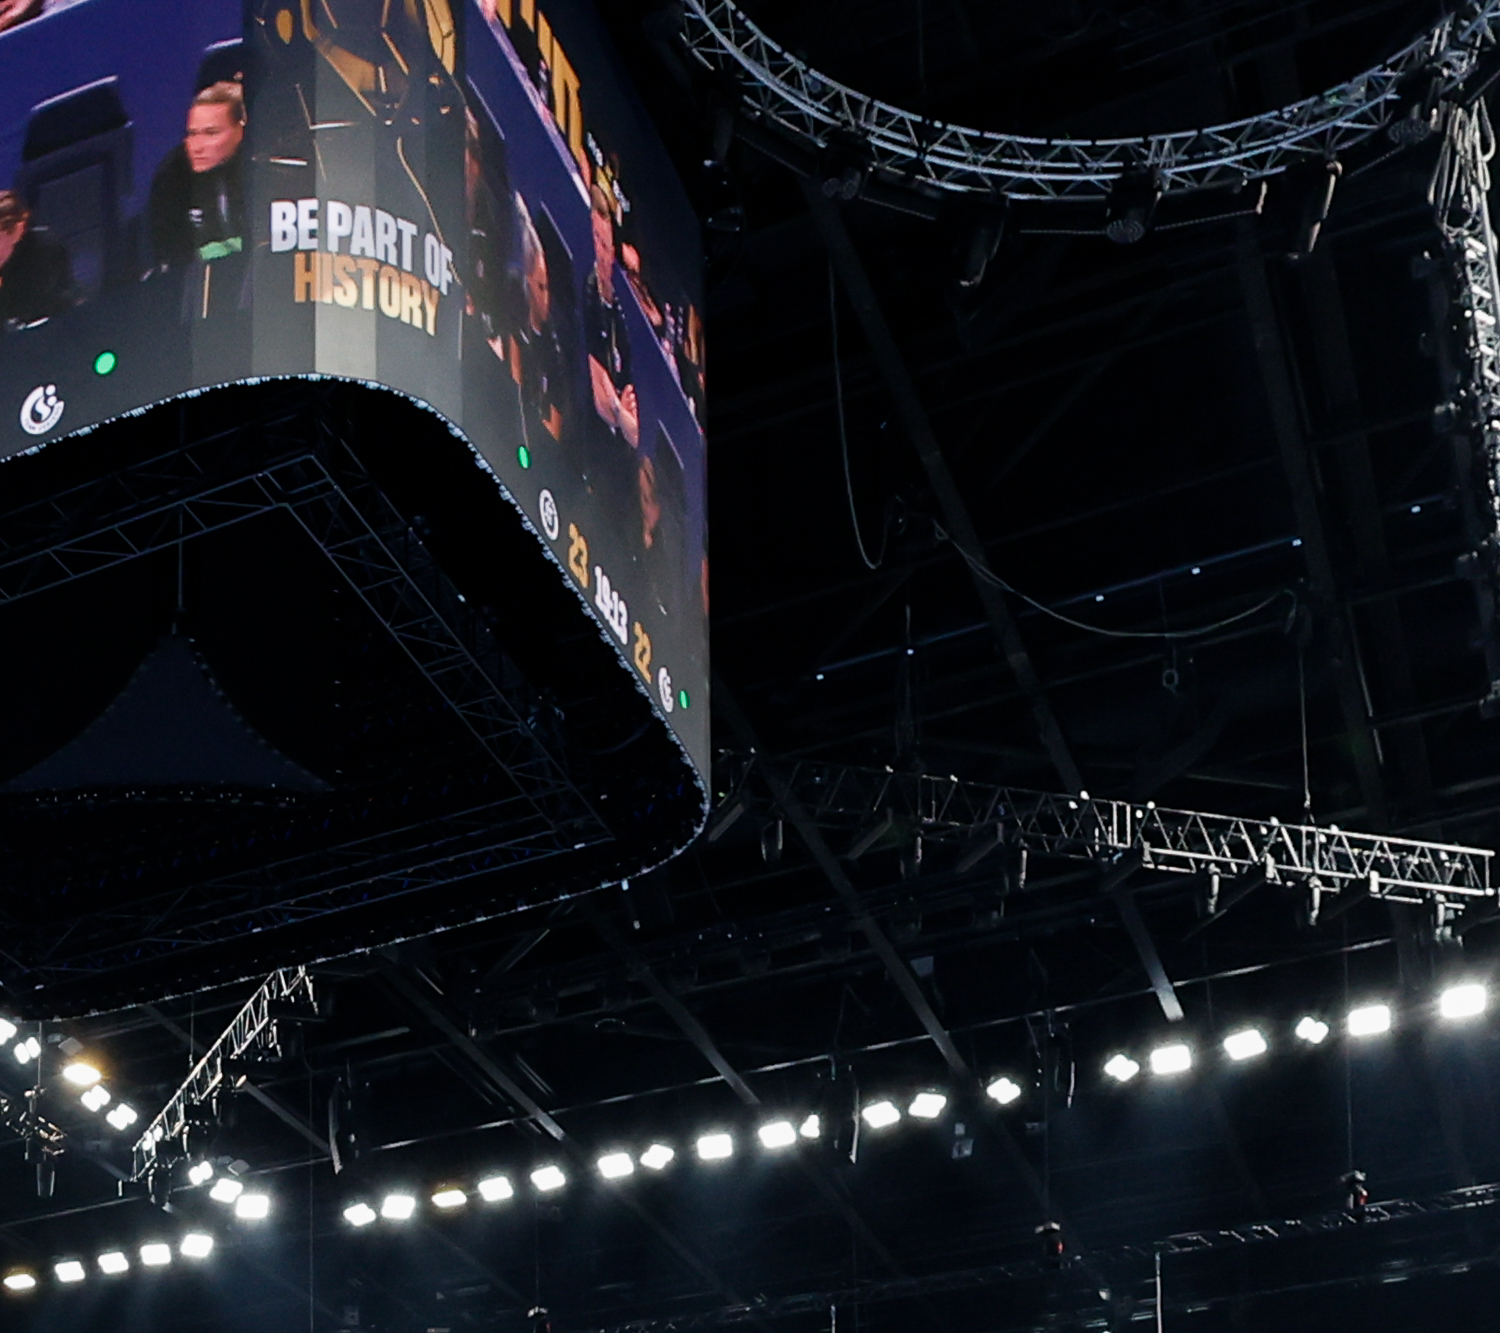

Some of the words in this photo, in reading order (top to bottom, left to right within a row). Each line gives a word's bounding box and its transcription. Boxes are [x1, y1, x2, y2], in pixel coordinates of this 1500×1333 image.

[271, 198, 317, 253] BE
[326, 200, 416, 266] PART
[423, 231, 453, 292] OF
[294, 254, 440, 335] HISTORY
[567, 523, 588, 588] 23
[593, 566, 627, 643] 19:13
[633, 621, 651, 684] 22
